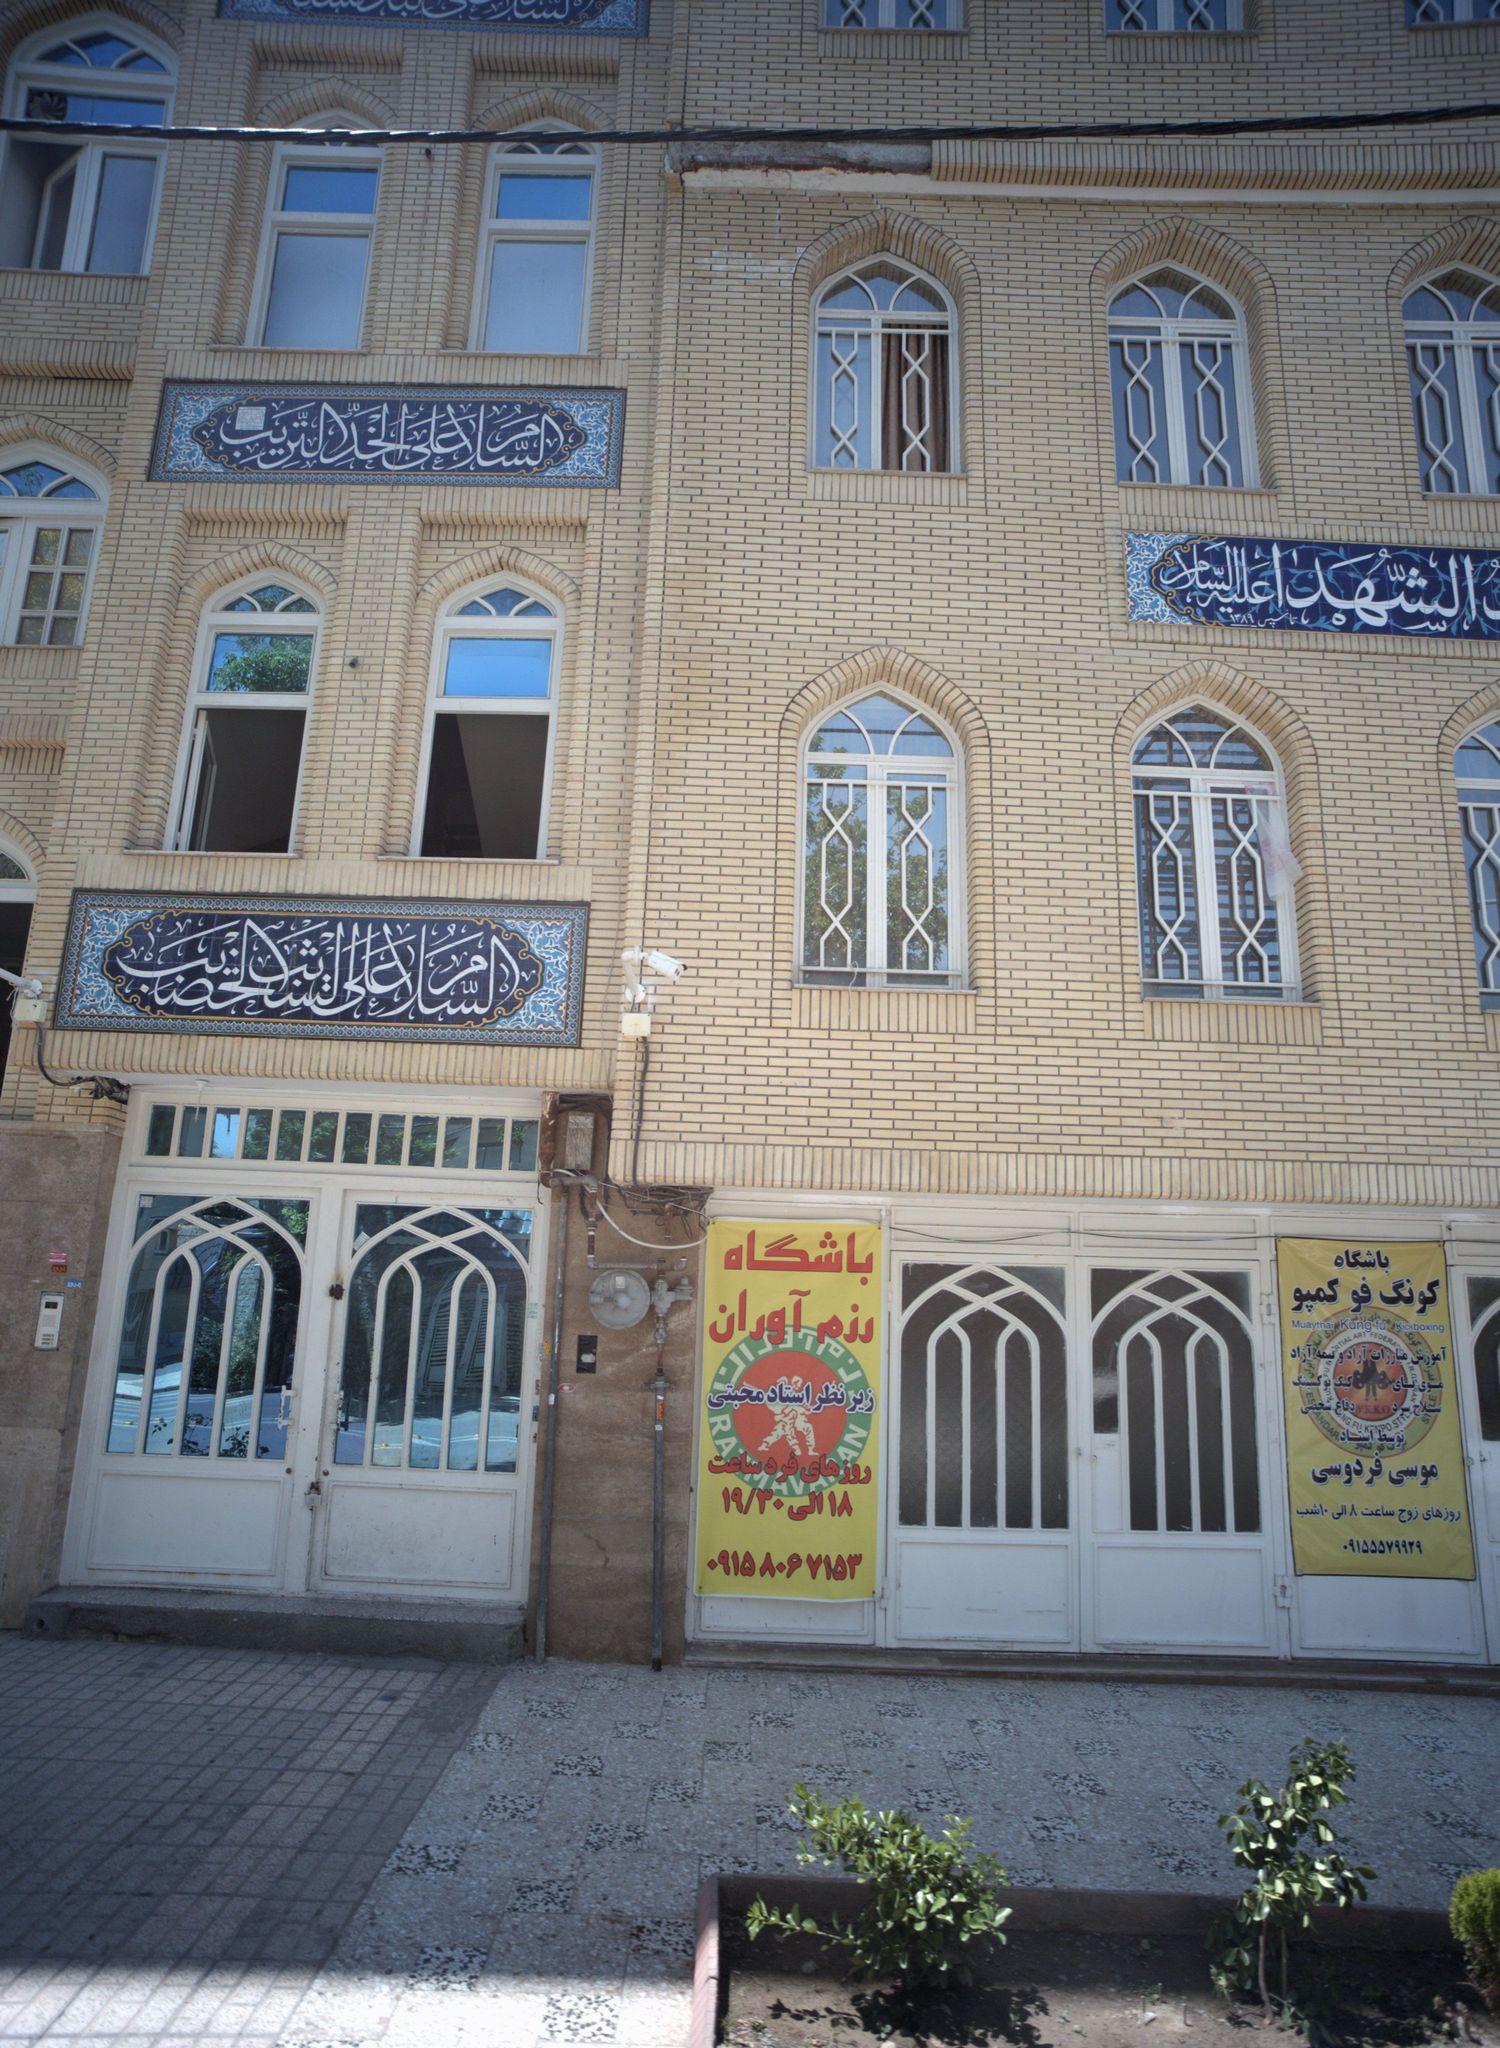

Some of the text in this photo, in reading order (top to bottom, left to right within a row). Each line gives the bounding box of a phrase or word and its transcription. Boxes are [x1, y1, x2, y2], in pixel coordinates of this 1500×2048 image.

[1229, 613, 1255, 627] ۱۳۸۹
[724, 1229, 874, 1286] باشگاه
[1334, 1248, 1390, 1275] باشگاه
[1291, 1276, 1440, 1314] کونگ فو کمپو
[708, 1288, 874, 1345] رزم آوران
[1340, 1320, 1372, 1332] Kung
[1375, 1319, 1387, 1330] fu
[1395, 1322, 1445, 1333] Kickboxing
[1290, 1345, 1312, 1363] آزاد
[1338, 1350, 1344, 1364] و
[1346, 1345, 1367, 1364] آزاد
[1411, 1346, 1447, 1366] آموزش
[1333, 1376, 1352, 1392] کیک
[707, 1381, 875, 1413] زیر نظر استاد محبتی
[1301, 1400, 1332, 1415] شخصی
[1335, 1399, 1356, 1417] دفاع
[1391, 1402, 1411, 1416] سرد
[1412, 1401, 1442, 1416] سلاح
[1339, 1429, 1373, 1444] استاد
[1376, 1429, 1406, 1448] توسط
[707, 1452, 763, 1475] ساعت
[764, 1452, 799, 1483] فرد
[1311, 1451, 1439, 1487] موسی فردوسی
[787, 1490, 824, 1522] الی
[828, 1490, 853, 1517] ۱۸
[1331, 1503, 1347, 1520] الی
[1349, 1503, 1358, 1517] ۸
[1360, 1504, 1395, 1517] ساعت
[1397, 1505, 1419, 1523] زوج
[1421, 1506, 1462, 1524] روزهای
[707, 1549, 863, 1581] ۰۹۱۵ ۸۰۶ ۷۱۵۳
